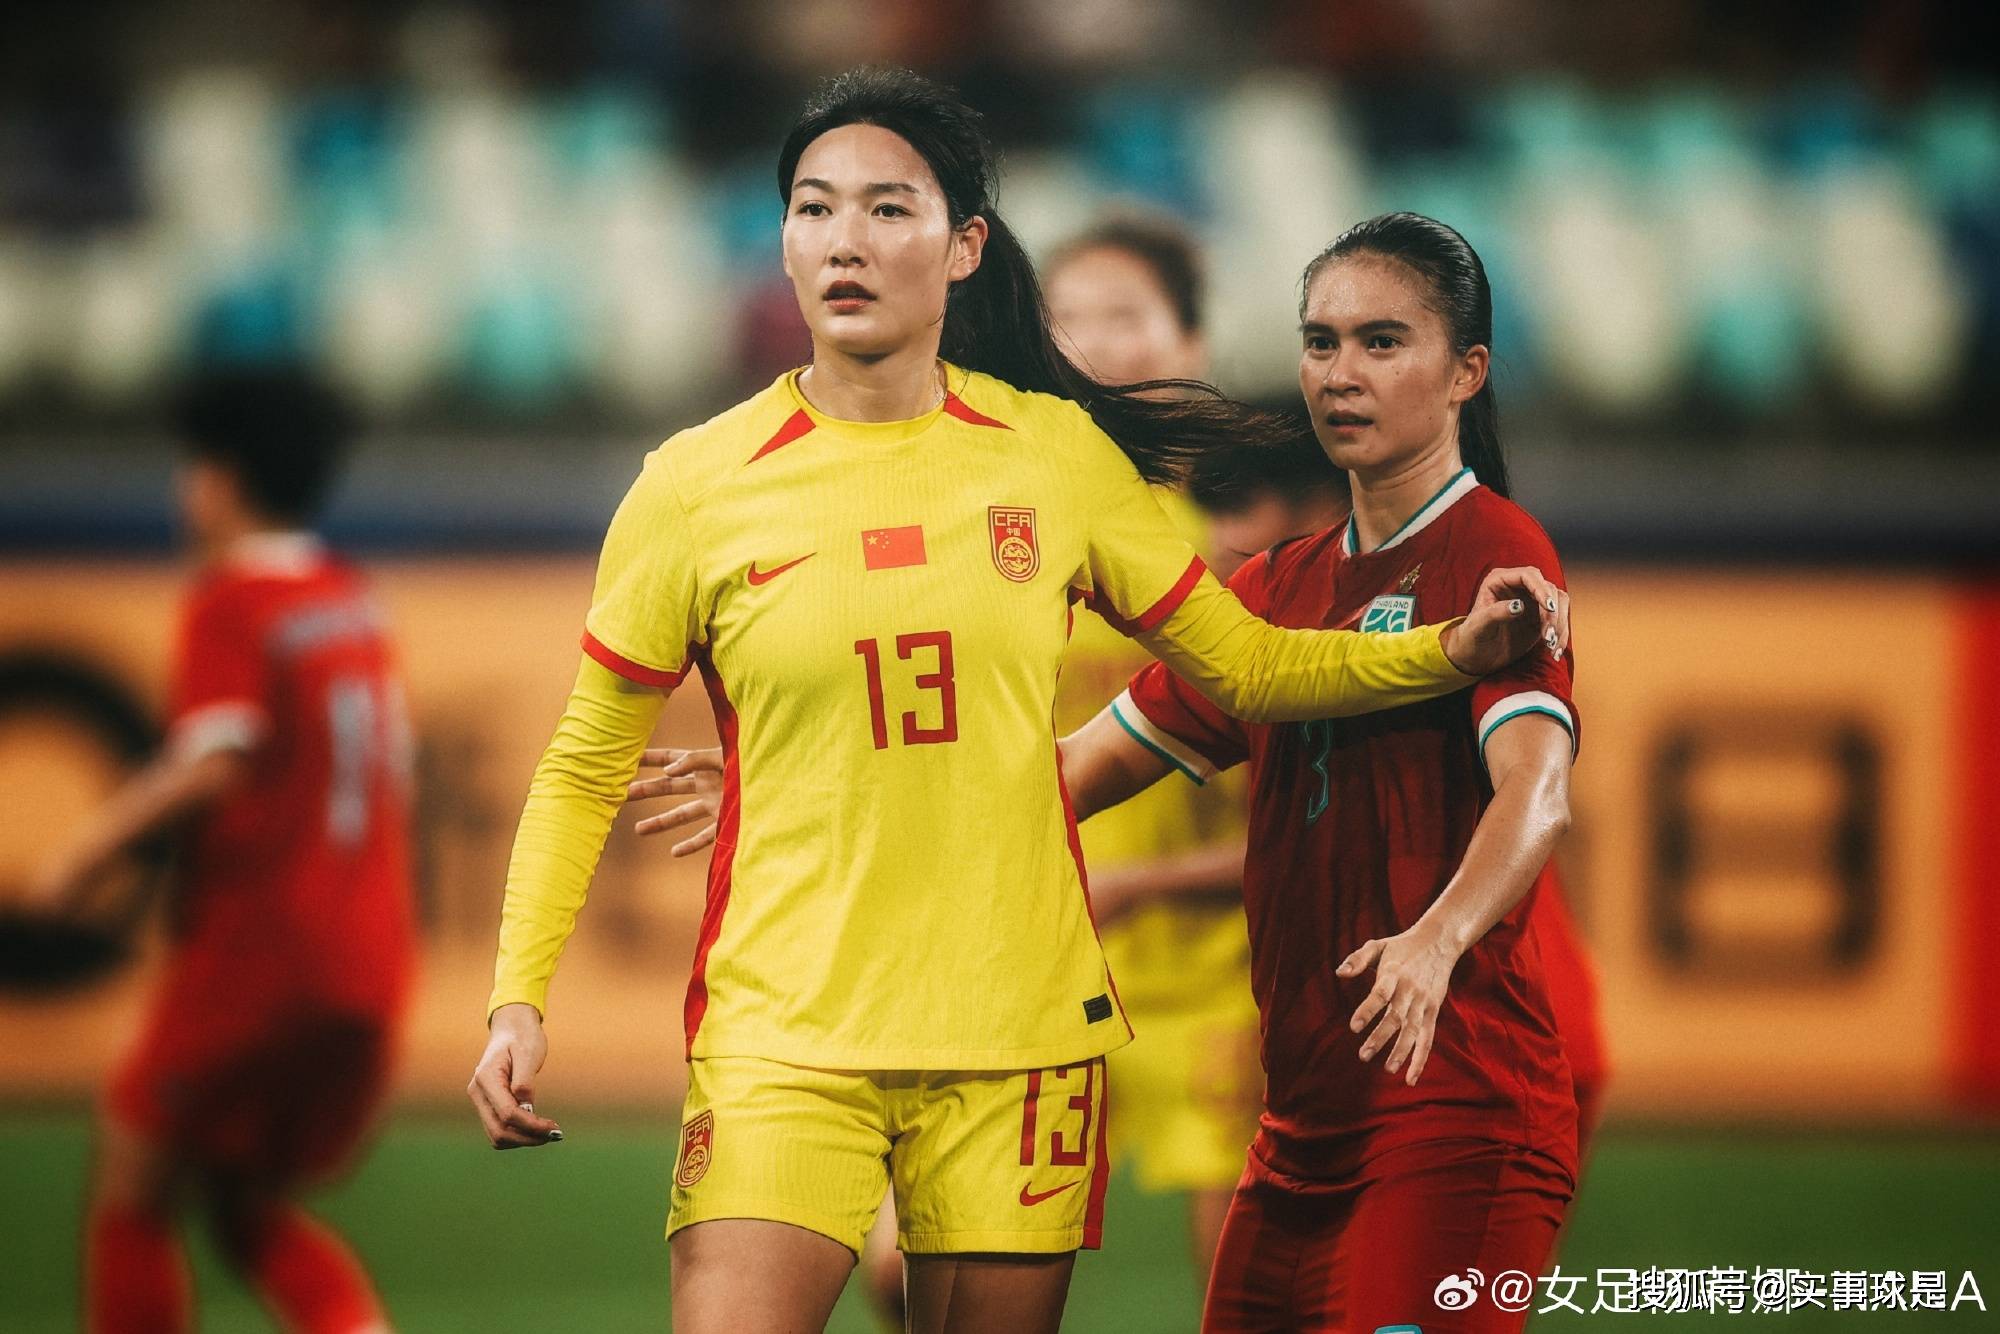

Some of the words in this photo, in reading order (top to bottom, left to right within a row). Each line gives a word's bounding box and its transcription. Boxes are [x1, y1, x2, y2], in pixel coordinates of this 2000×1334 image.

[994, 513, 1031, 527] CFA
[1375, 600, 1409, 609] THAILAND
[854, 630, 958, 751] 13
[1020, 1062, 1093, 1166] 13
[686, 1118, 710, 1142] CFA
